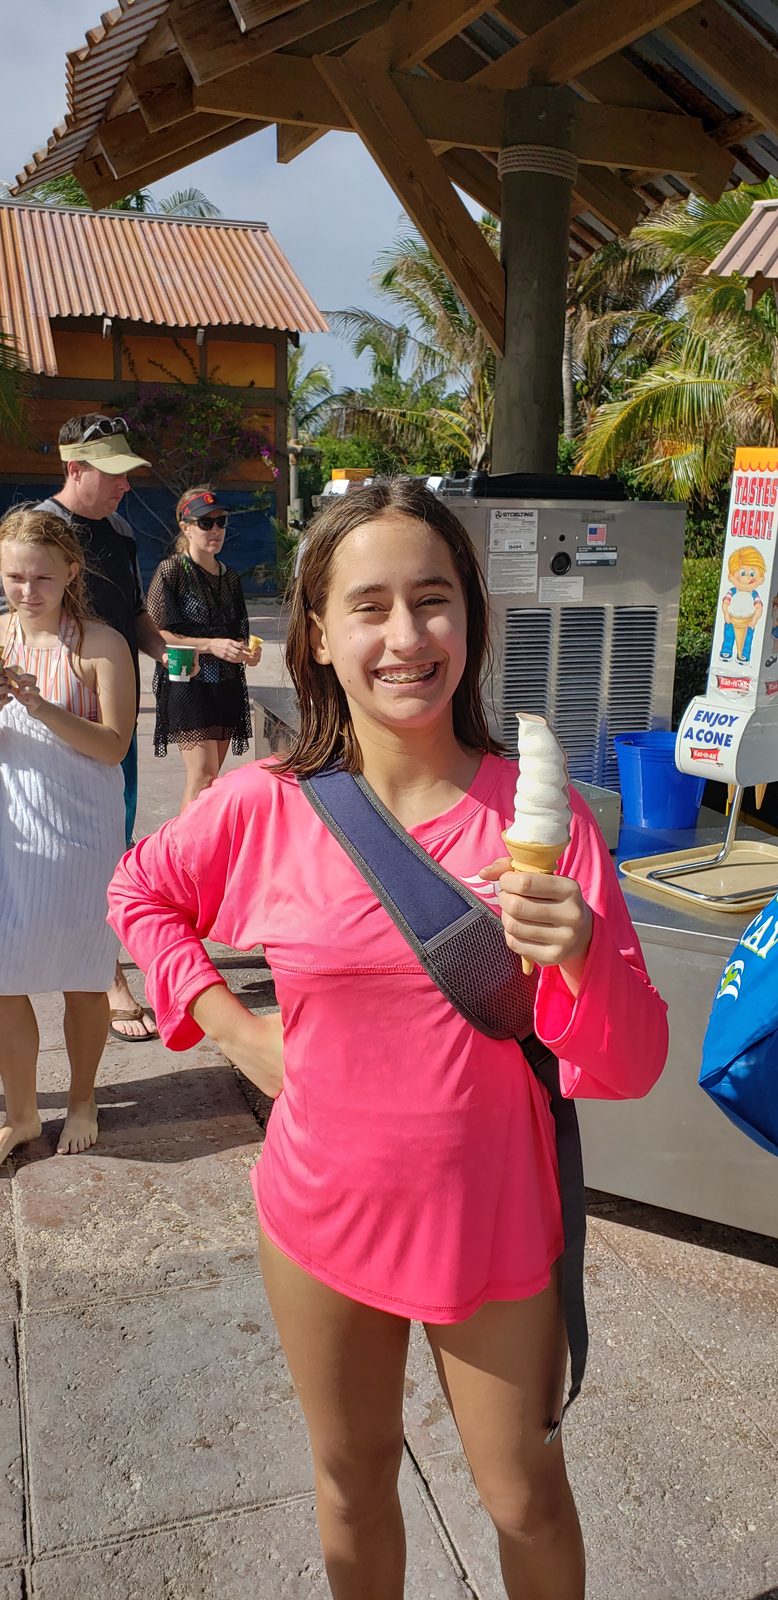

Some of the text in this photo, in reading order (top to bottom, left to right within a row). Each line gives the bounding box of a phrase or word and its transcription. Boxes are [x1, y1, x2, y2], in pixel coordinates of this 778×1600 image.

[735, 476, 778, 507] TASTES
[731, 509, 774, 540] GREAT!
[693, 709, 740, 727] ENJOY
[683, 726, 734, 747] A CONE
